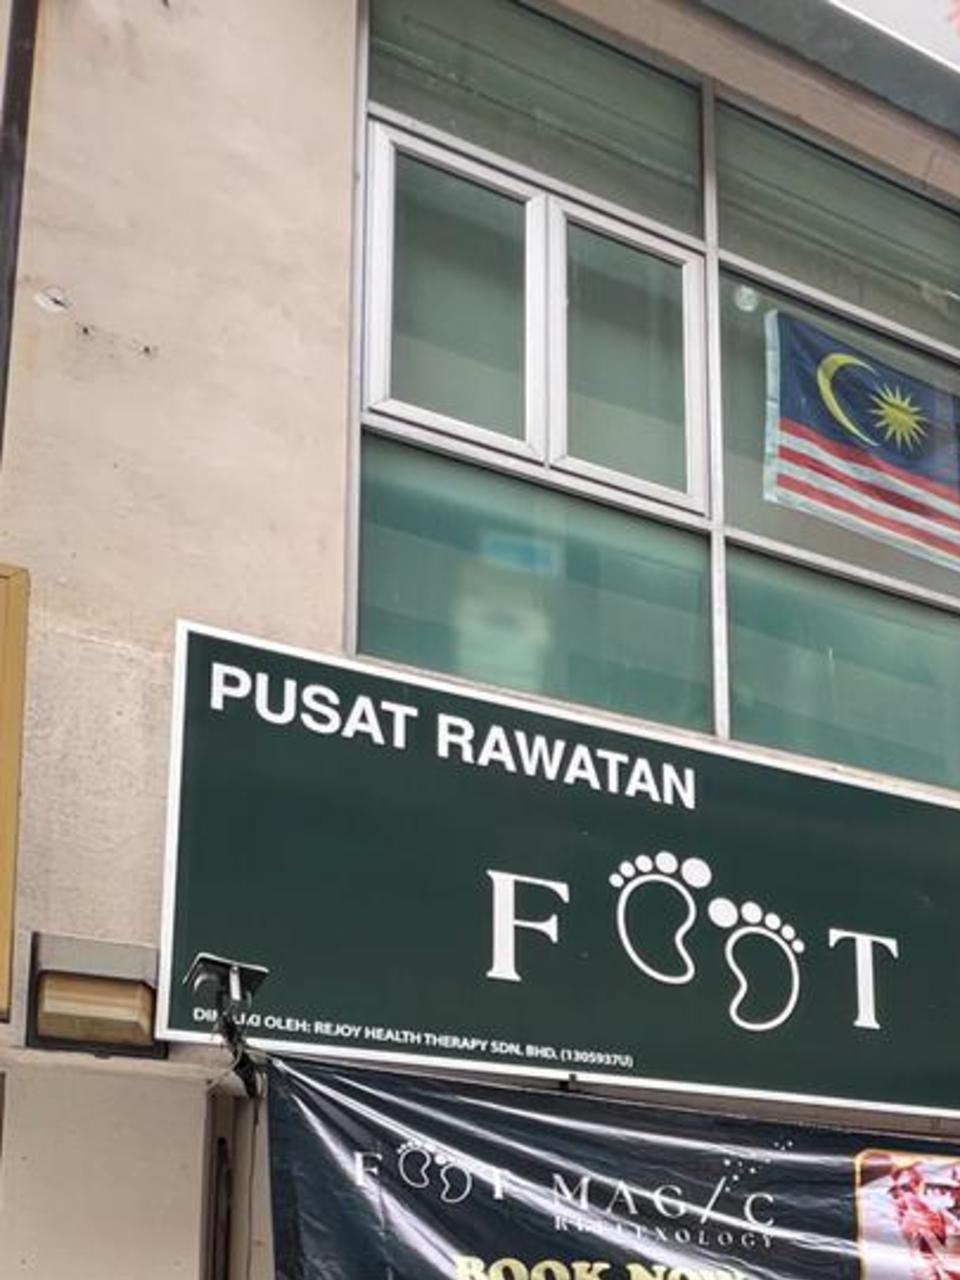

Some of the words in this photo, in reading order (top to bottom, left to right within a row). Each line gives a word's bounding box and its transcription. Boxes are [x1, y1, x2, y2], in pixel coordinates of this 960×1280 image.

[209, 661, 418, 750] PUSAT
[436, 713, 697, 810] RAWATAN
[263, 1015, 311, 1033] OLEH:
[314, 1020, 362, 1039] REJOY
[364, 1026, 421, 1045] HEALTH
[423, 1032, 489, 1052] THERAPY
[490, 1042, 524, 1056] SDN.
[525, 1045, 558, 1060] BHD.
